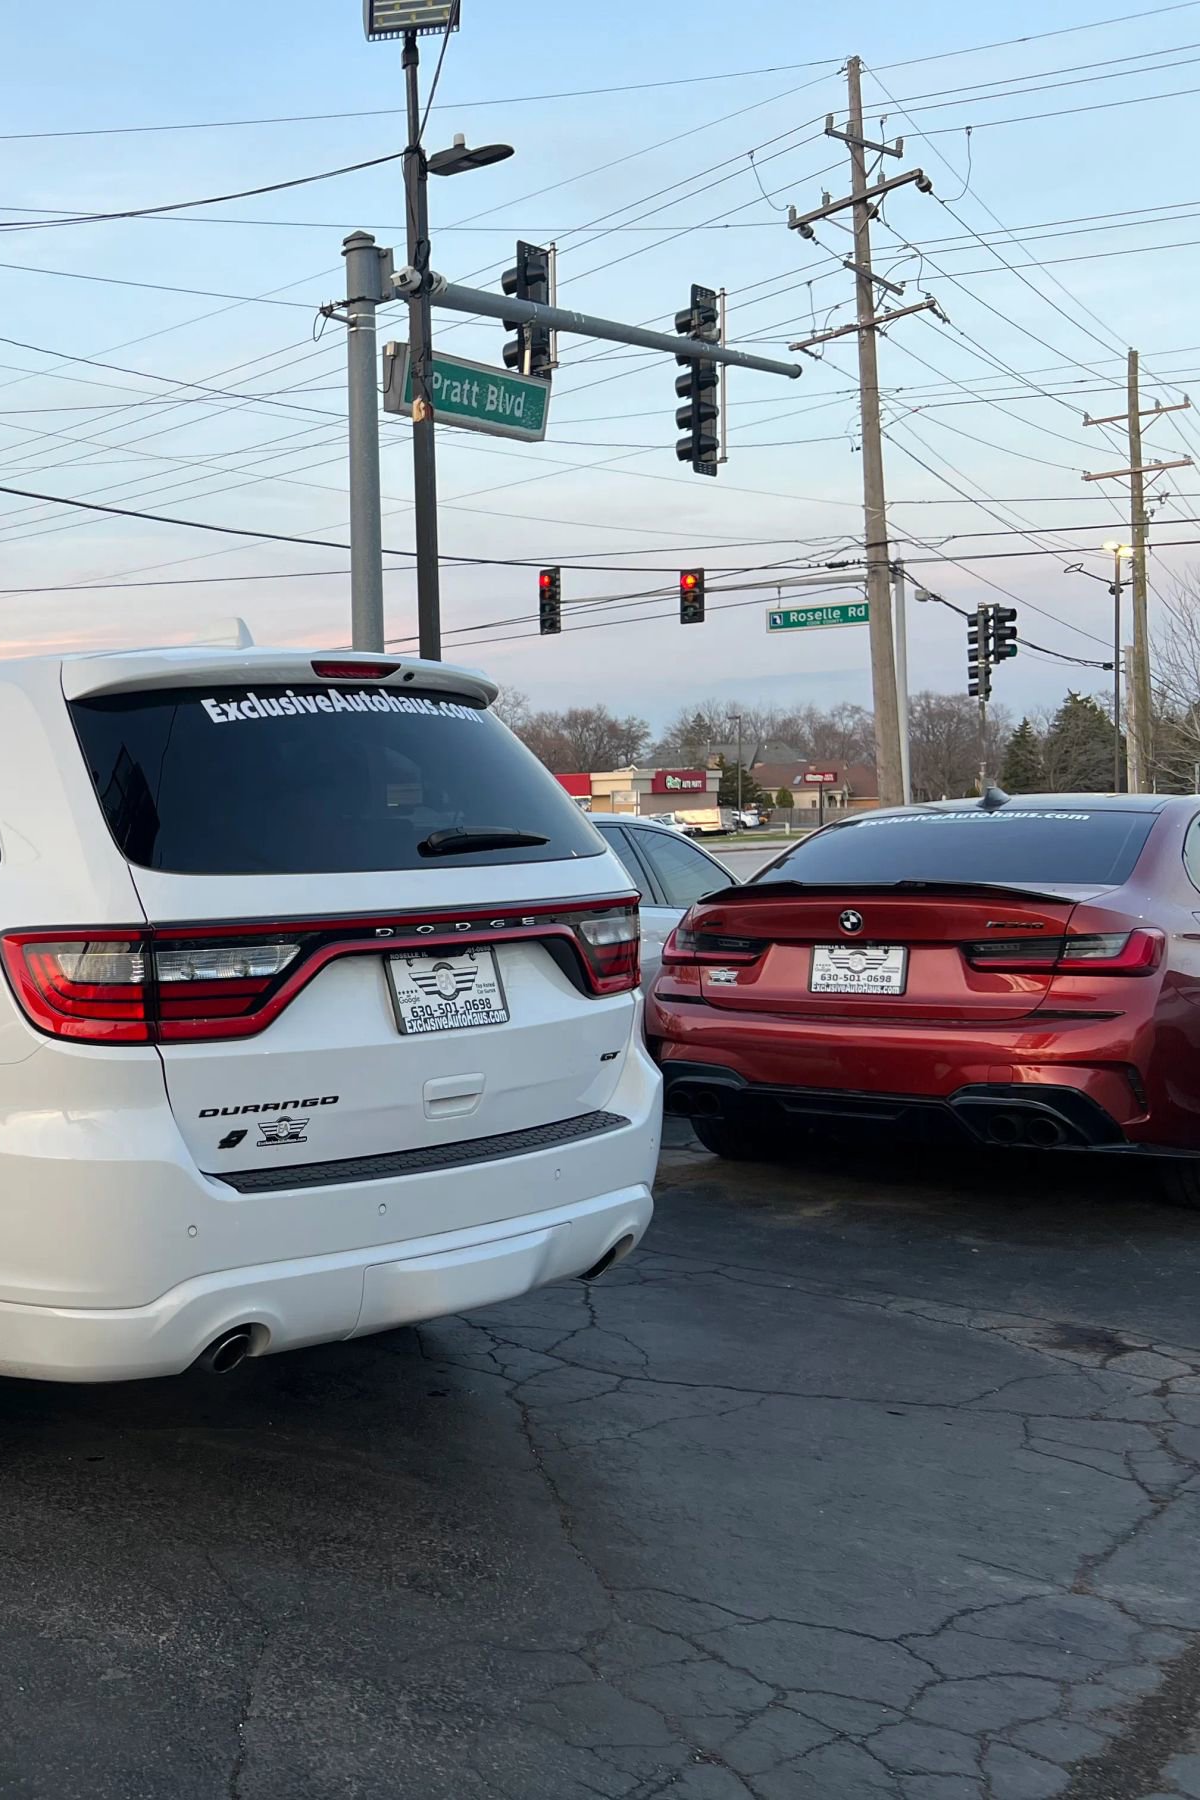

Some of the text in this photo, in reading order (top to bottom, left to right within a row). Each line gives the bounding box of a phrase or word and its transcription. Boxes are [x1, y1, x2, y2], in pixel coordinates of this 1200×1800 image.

[431, 371, 527, 418] Pratt Blvd
[789, 604, 866, 623] Roselle Rd
[200, 688, 485, 724] ExclusiveAutohaus.com
[855, 809, 1091, 829] ExclusiveAutohaus.com
[375, 916, 536, 938] DODGE
[820, 973, 892, 983] 630-501-0698
[410, 997, 492, 1019] 630-501-0698
[405, 1009, 508, 1034] ExclusiveAutoHaus.com
[599, 1050, 621, 1062] GT
[198, 1095, 340, 1118] DURANGO
